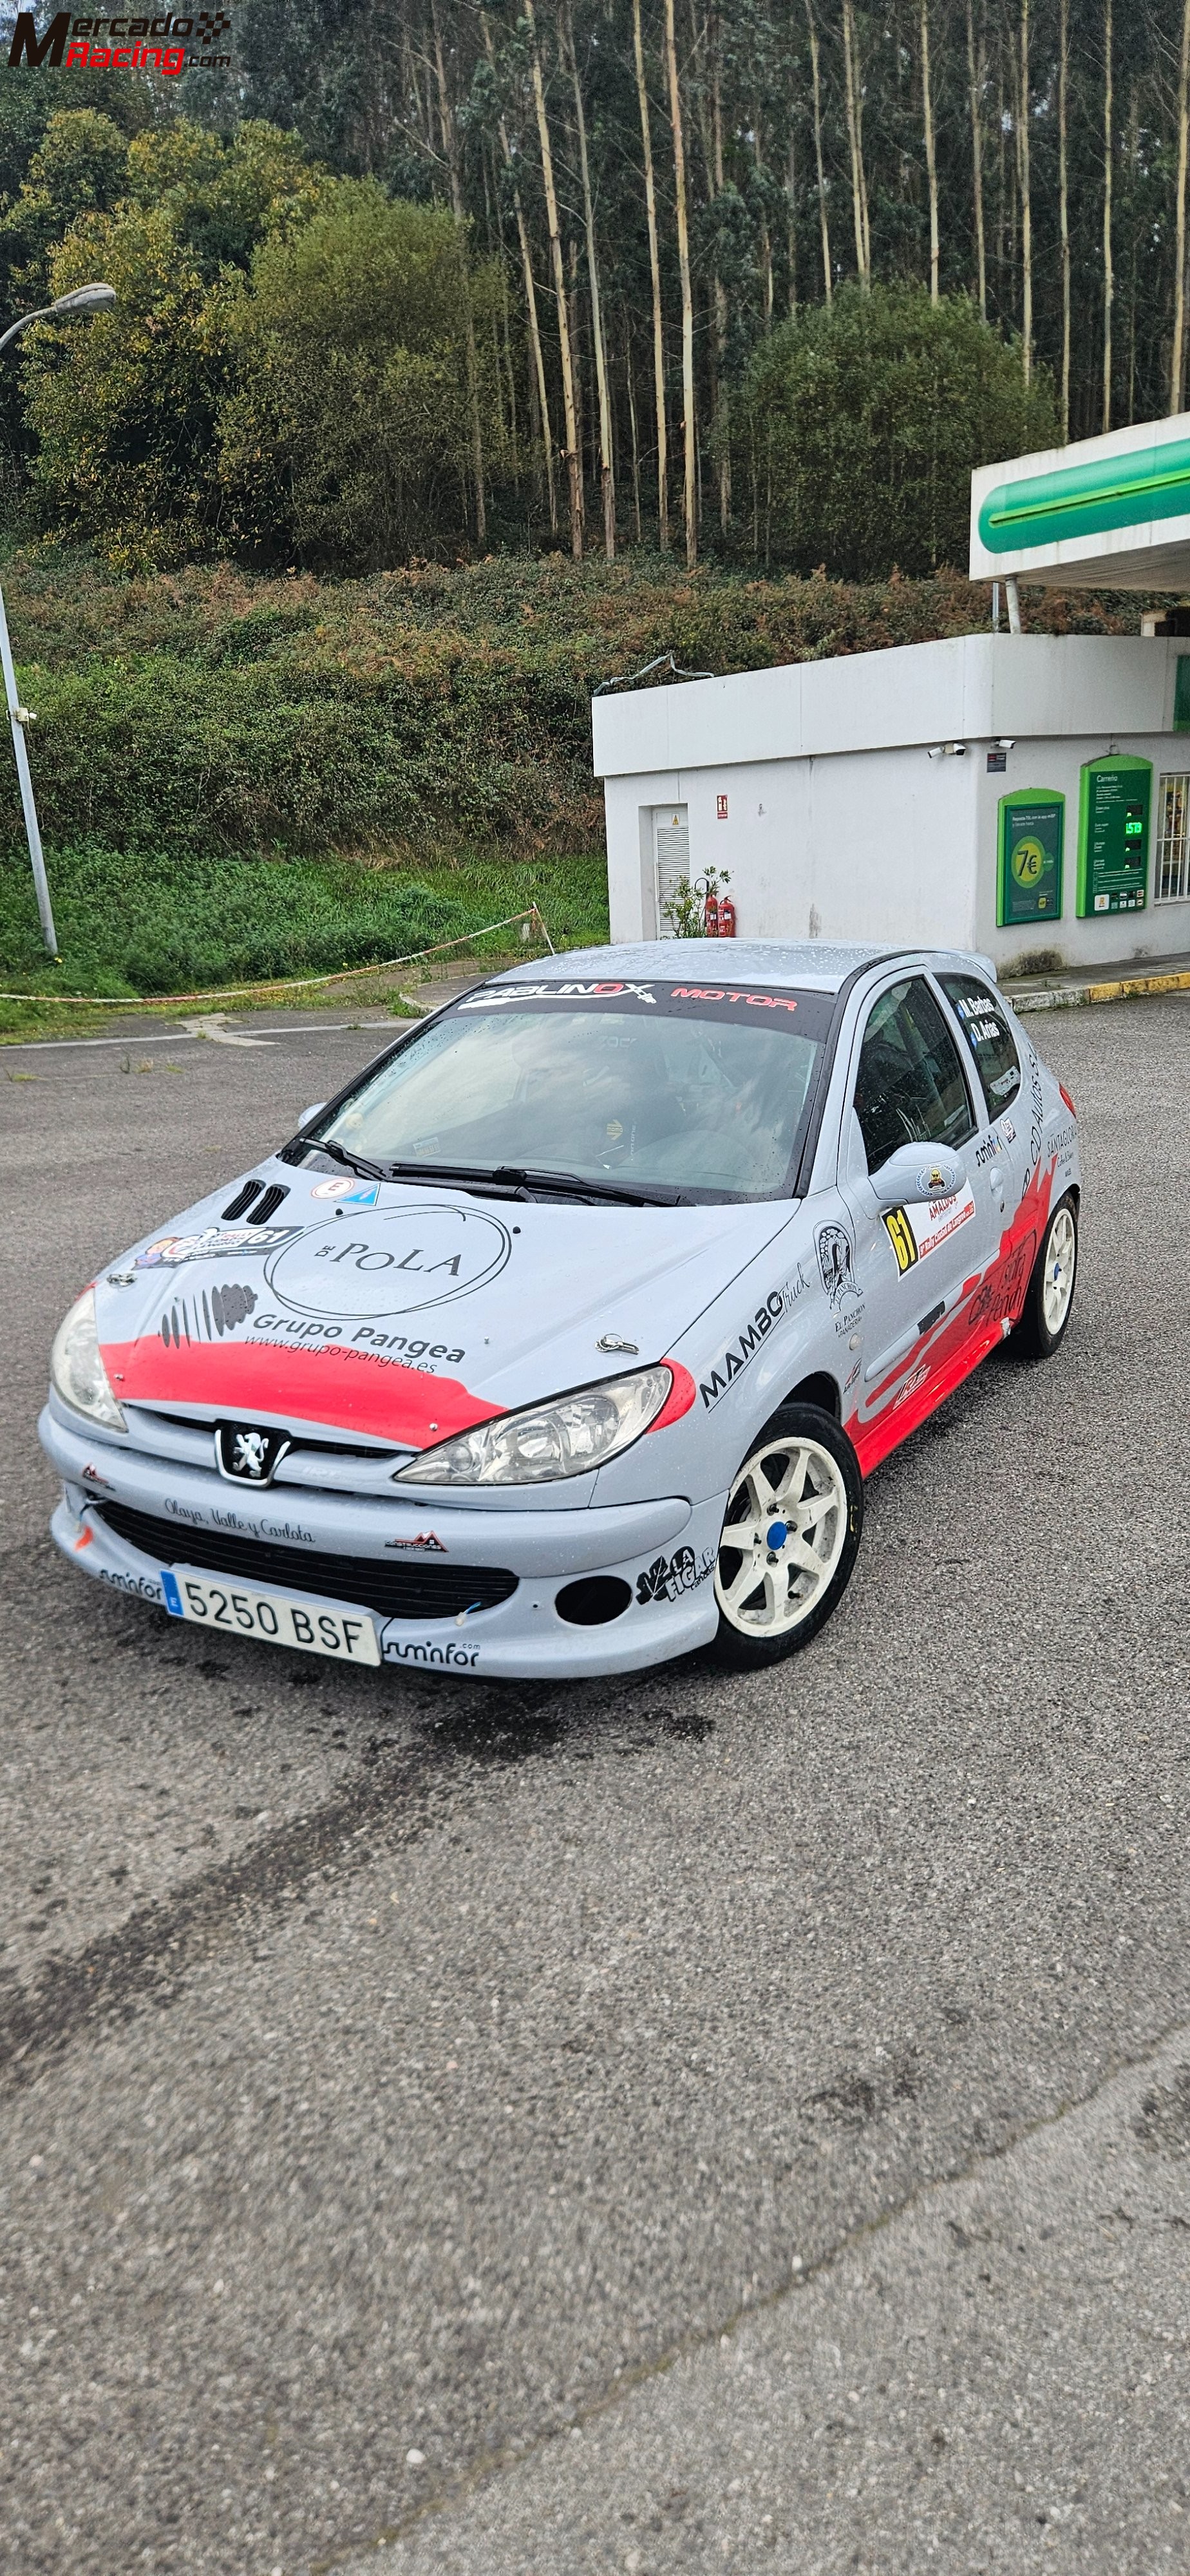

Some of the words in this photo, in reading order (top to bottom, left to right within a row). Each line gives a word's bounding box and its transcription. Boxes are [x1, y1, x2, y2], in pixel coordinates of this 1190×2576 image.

[466, 983, 656, 1003] PABLINOX
[670, 987, 798, 1011] MOTOR
[967, 996, 995, 1016] Barbas
[970, 1023, 983, 1041] D.
[979, 1019, 1000, 1039] Arias
[328, 1182, 345, 1191] E
[247, 1229, 290, 1244] 61
[887, 1209, 916, 1270] 61
[314, 1245, 336, 1257] DE
[330, 1243, 462, 1276] POLA
[253, 1314, 343, 1339] Grupo
[351, 1327, 466, 1363] Pangea
[699, 1291, 783, 1408] MAMBO
[776, 1262, 811, 1313] Truck
[245, 1335, 438, 1374] www.grupo-pangea.es
[165, 1498, 209, 1524] Olaya,
[210, 1508, 248, 1531] Valle
[249, 1522, 260, 1539] y
[260, 1519, 316, 1543] Carlota
[665, 1547, 715, 1602] FIGAR
[672, 1549, 694, 1573] LA
[169, 1596, 178, 1607] E
[184, 1581, 279, 1635] 5250
[290, 1607, 363, 1654] BSF
